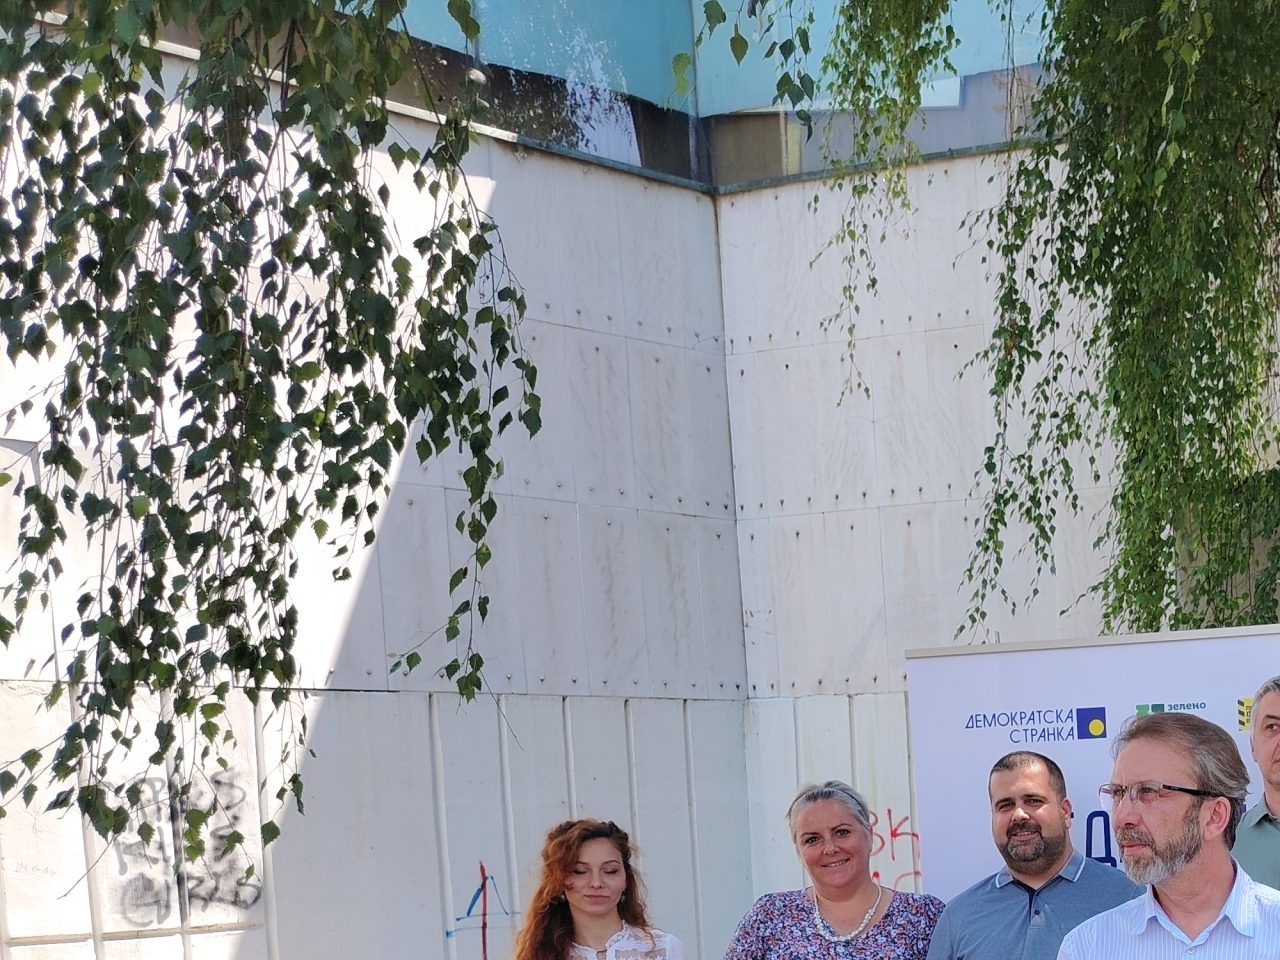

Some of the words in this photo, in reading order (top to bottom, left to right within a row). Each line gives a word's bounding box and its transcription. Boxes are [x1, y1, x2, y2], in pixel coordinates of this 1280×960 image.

[1167, 701, 1207, 712] зелено
[965, 708, 1075, 730] ДЕМОКРАТСКА
[1009, 725, 1076, 744] СТРАНКА
